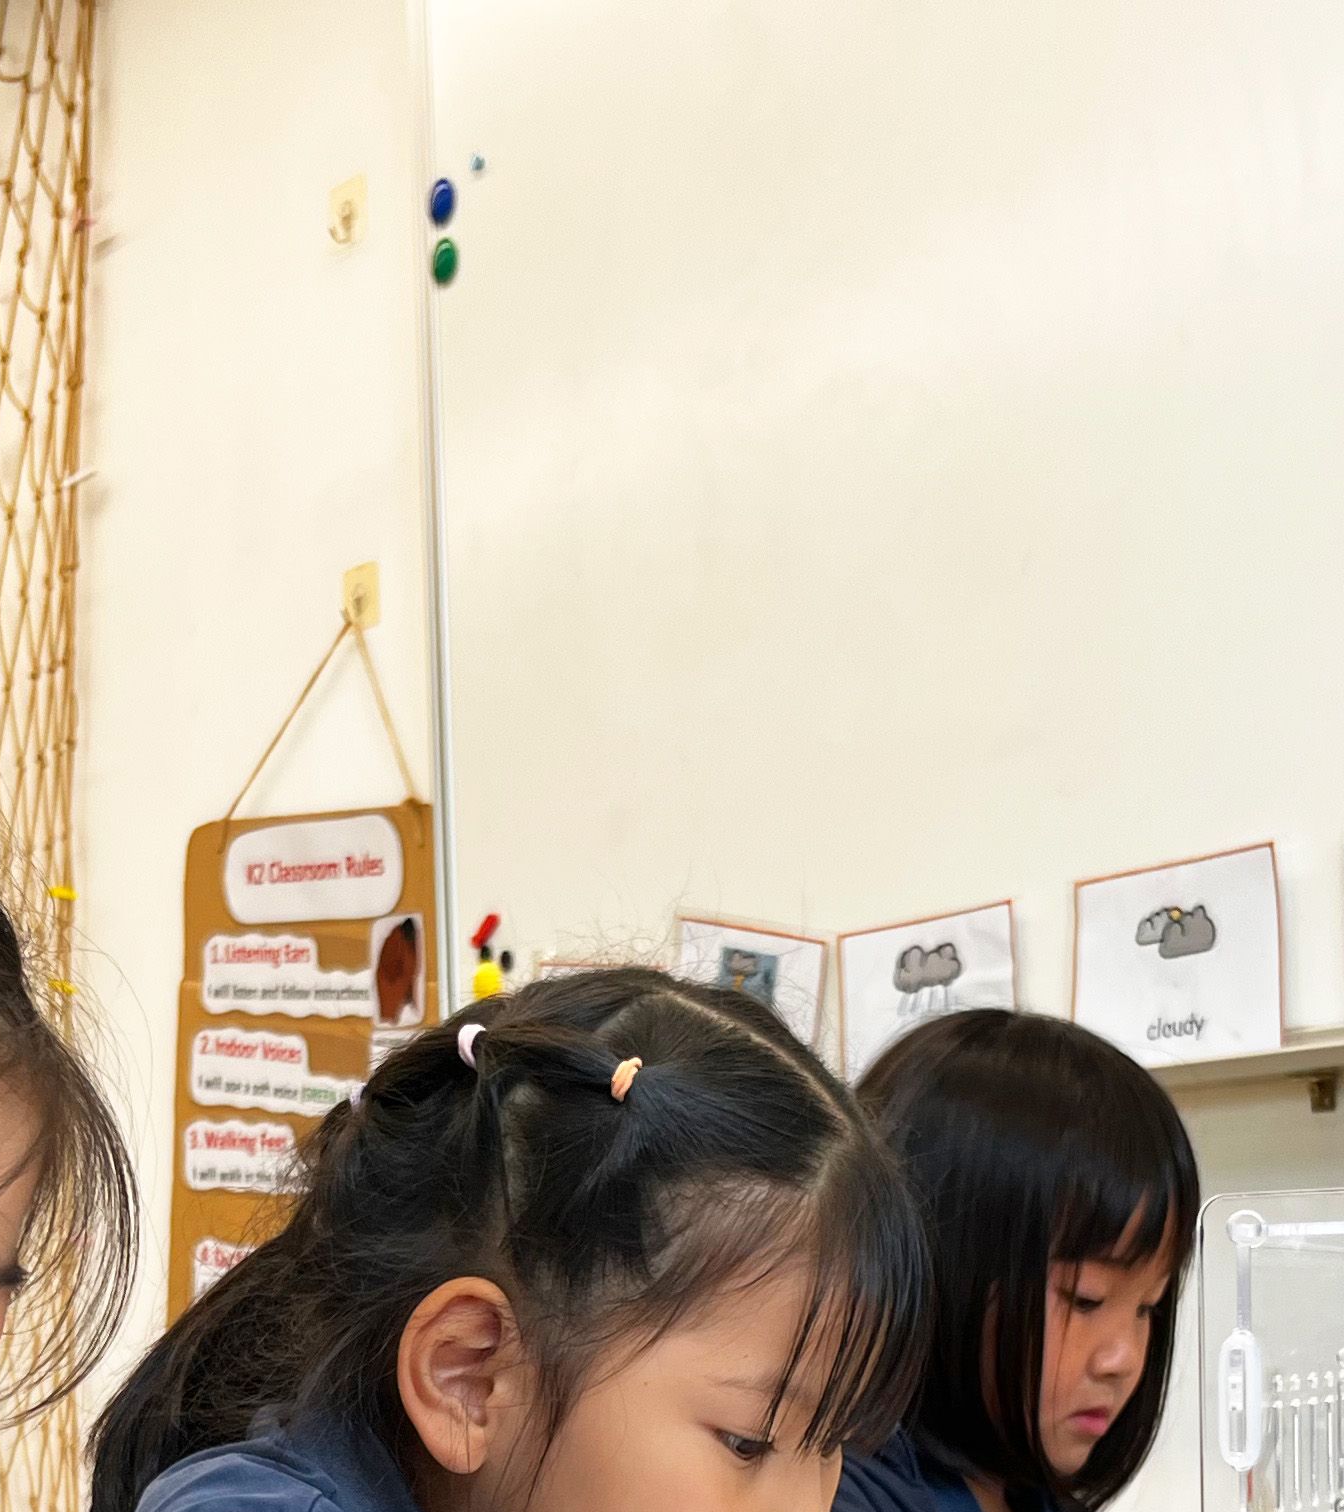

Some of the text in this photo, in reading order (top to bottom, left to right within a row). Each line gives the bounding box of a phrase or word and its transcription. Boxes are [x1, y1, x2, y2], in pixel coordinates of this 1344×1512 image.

[269, 860, 341, 884] Classroom
[346, 855, 385, 877] Rules
[1146, 1012, 1206, 1041] cloudy
